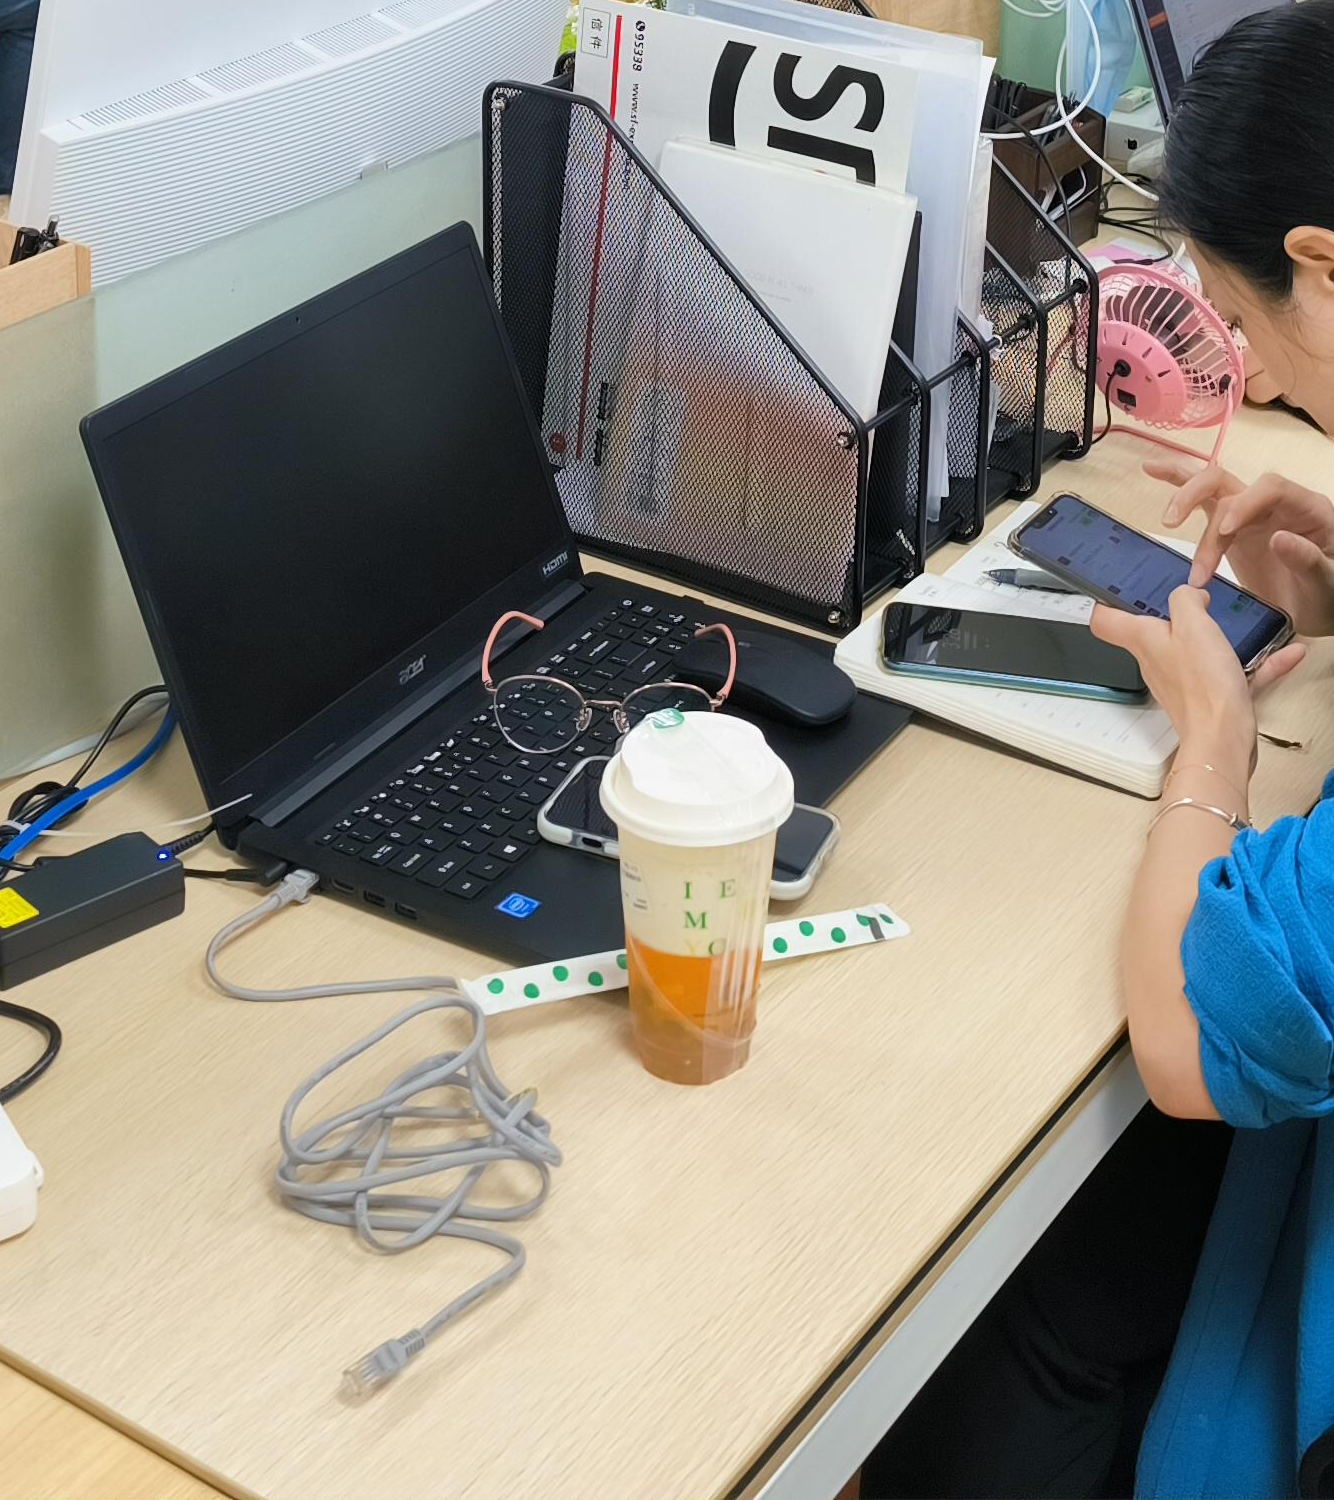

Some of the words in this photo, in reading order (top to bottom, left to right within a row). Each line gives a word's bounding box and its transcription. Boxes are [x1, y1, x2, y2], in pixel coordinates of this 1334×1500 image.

[590, 17, 604, 50] 信件
[632, 33, 645, 72] 95338
[399, 654, 427, 686] acer
